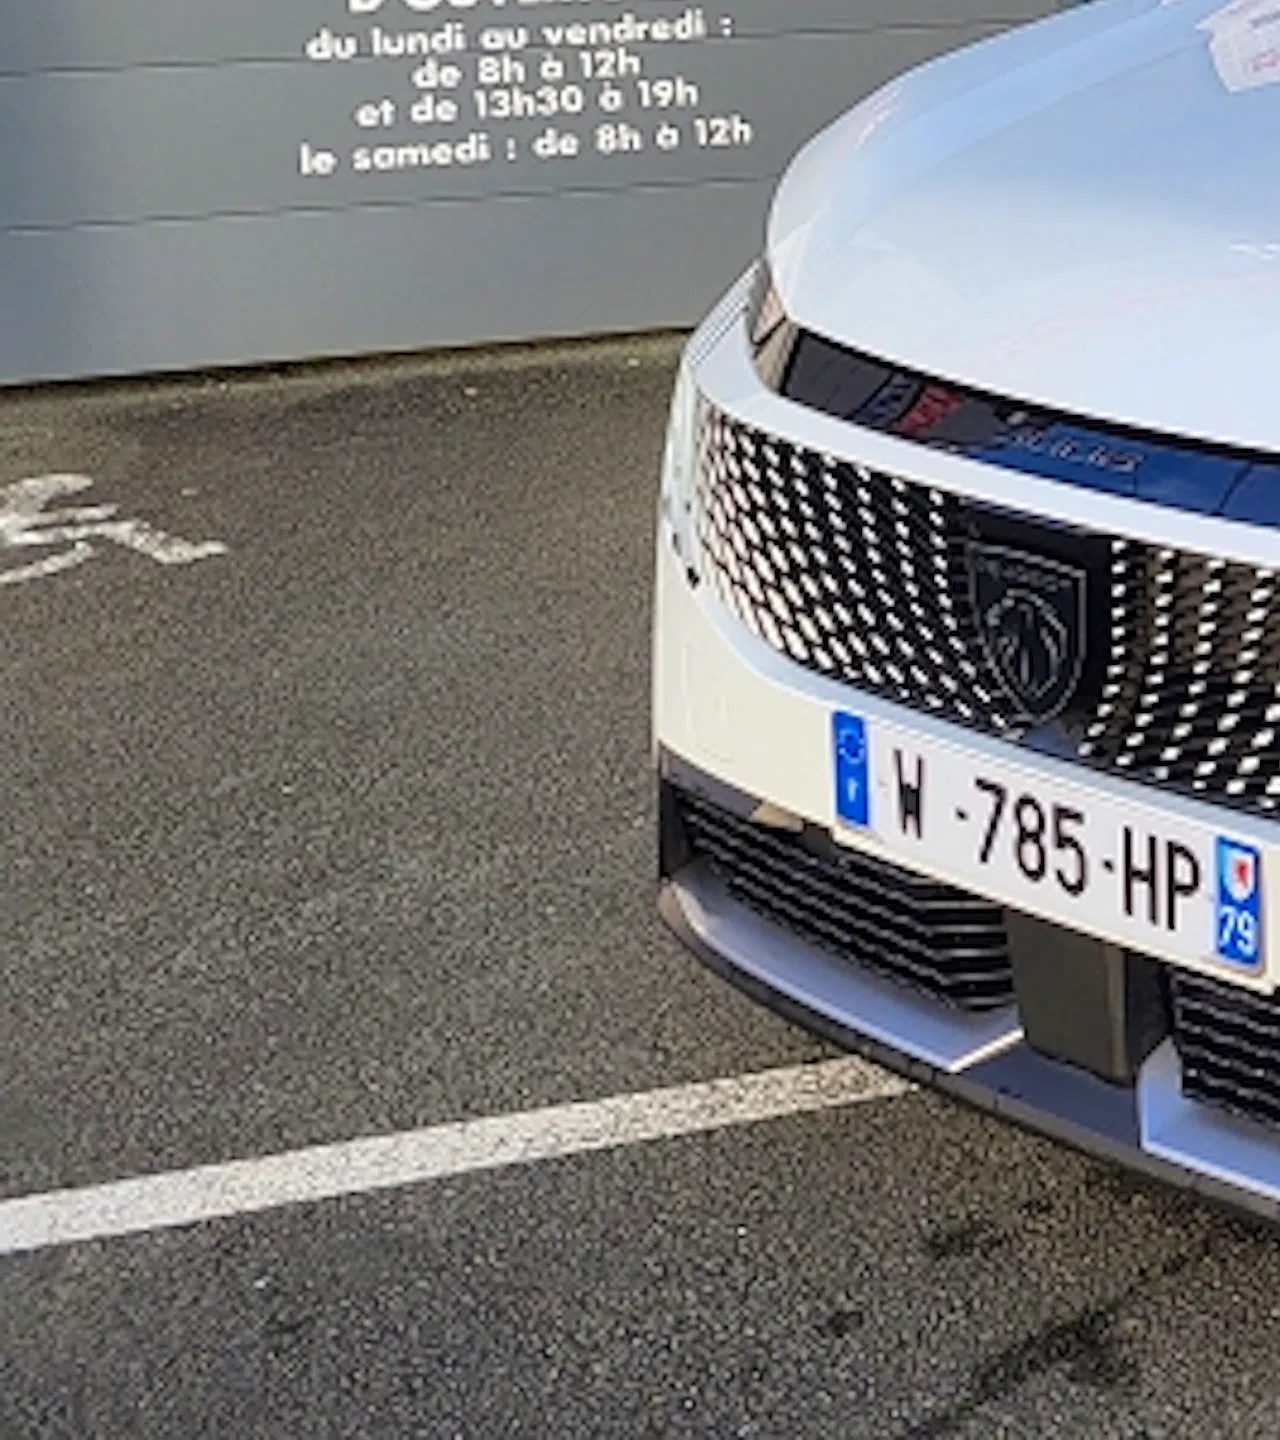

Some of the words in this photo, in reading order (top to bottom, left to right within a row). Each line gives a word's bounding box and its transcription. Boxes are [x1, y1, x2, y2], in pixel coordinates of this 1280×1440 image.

[306, 28, 355, 60] du
[372, 23, 465, 56] lundi
[480, 29, 526, 50] au
[542, 10, 705, 46] vendredi
[412, 59, 461, 90] de
[478, 58, 524, 86] 8h
[541, 54, 564, 80] à
[581, 49, 641, 79] 12h
[356, 98, 394, 128] et
[411, 93, 458, 123] de
[474, 87, 583, 118] 13h30
[599, 84, 623, 111] à
[638, 78, 699, 108] 19h
[299, 144, 337, 176] le
[352, 132, 491, 173] samedi
[534, 128, 580, 159] de
[596, 123, 641, 154] 8h
[656, 120, 680, 150] à
[693, 114, 753, 147] 12h
[1216, 905, 1255, 954] 79
